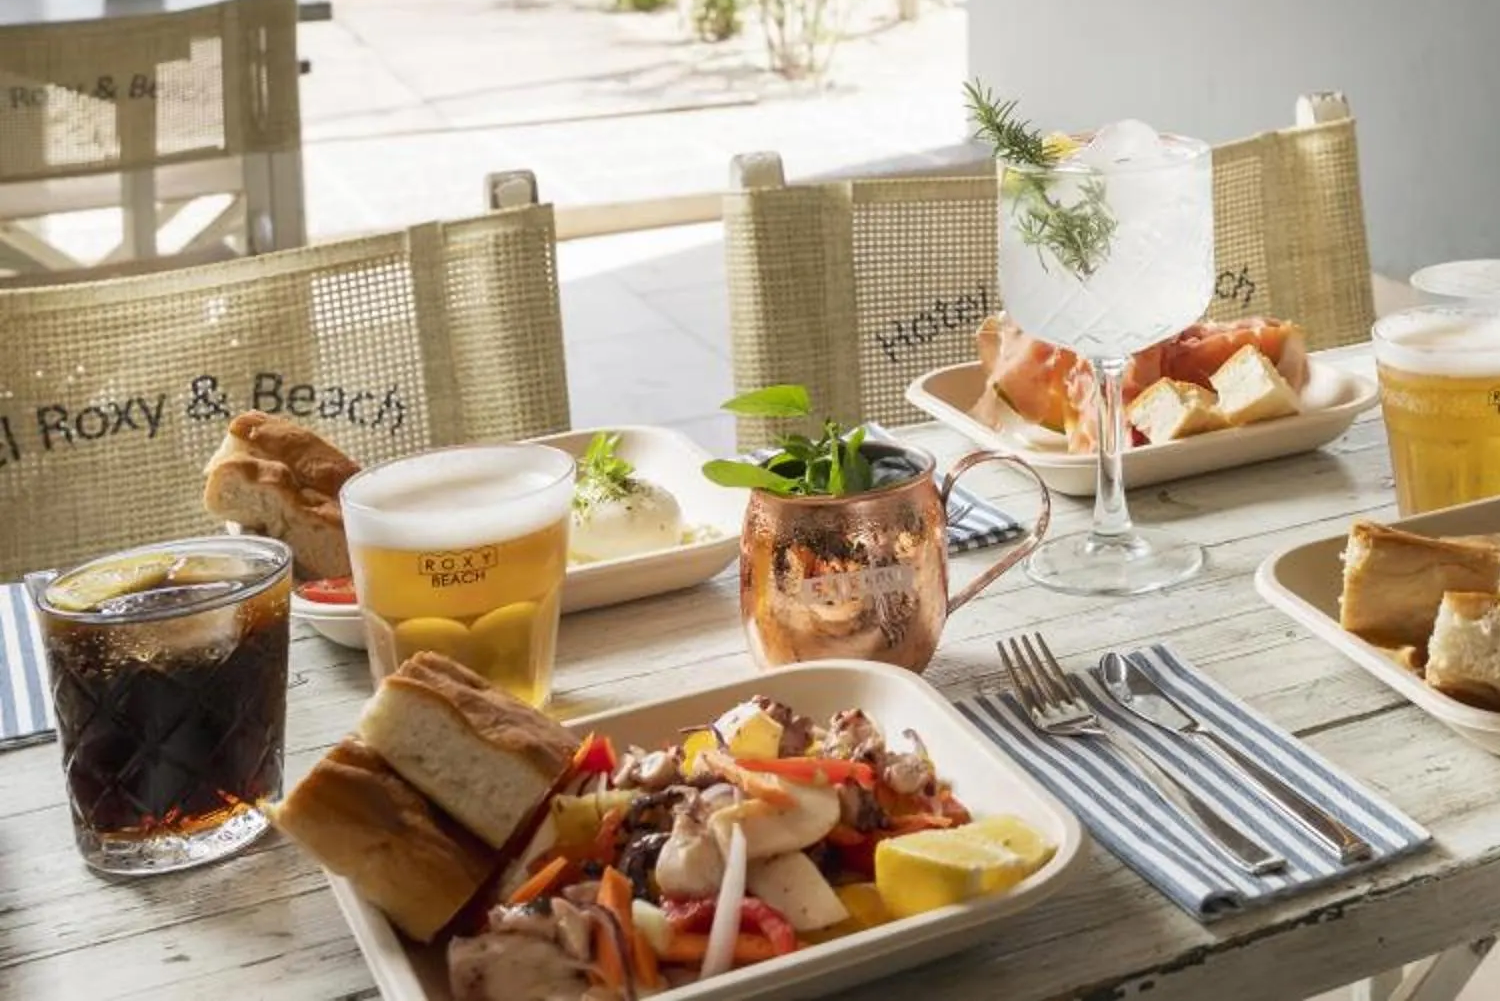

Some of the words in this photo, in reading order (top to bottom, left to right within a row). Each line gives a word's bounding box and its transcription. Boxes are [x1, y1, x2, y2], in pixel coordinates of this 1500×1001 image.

[94, 75, 119, 101] &
[36, 393, 167, 449] Roxy
[187, 375, 231, 420] &
[252, 372, 406, 437] Beach
[425, 549, 492, 572] ROXY
[431, 568, 486, 588] BEACH
